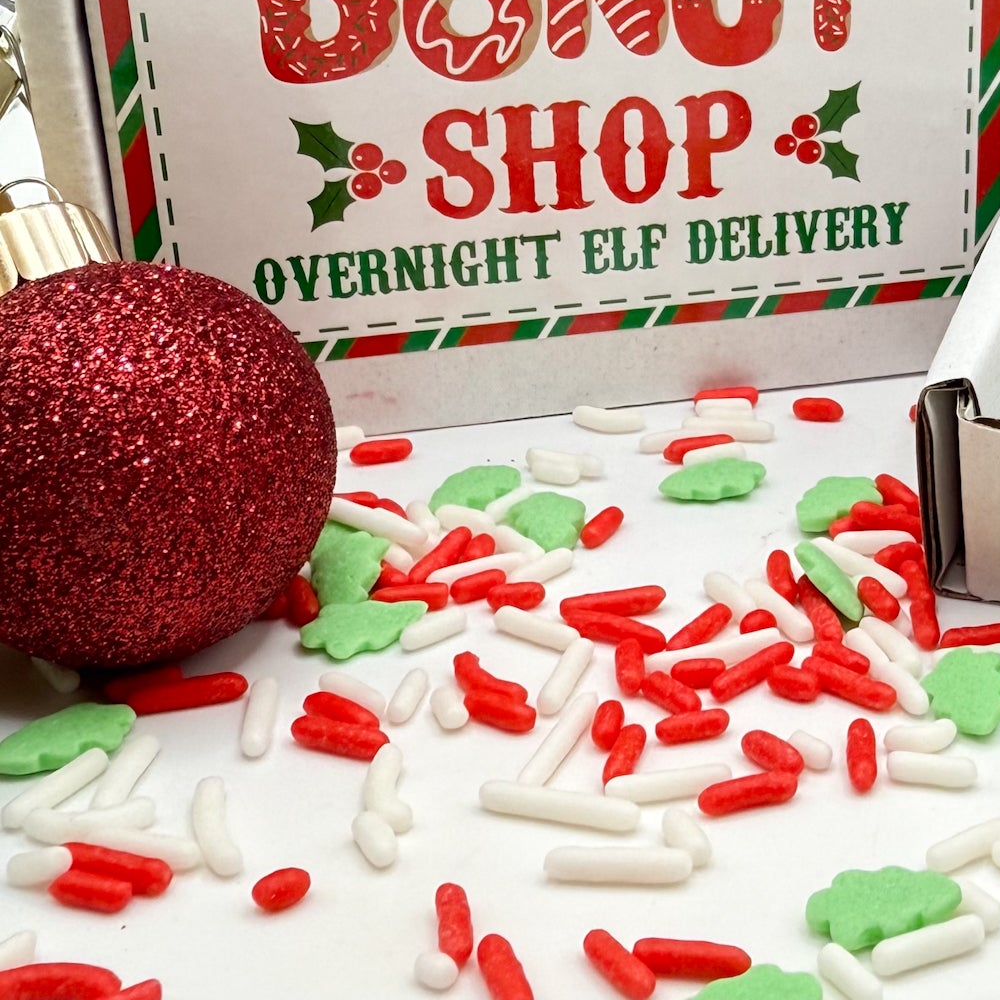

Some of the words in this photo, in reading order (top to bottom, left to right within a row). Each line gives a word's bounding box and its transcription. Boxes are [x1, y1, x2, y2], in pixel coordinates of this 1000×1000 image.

[423, 90, 753, 220] SHOP
[253, 230, 561, 306] OVERNIGHT
[581, 223, 667, 275] ELF
[686, 201, 911, 264] DELIVERY
